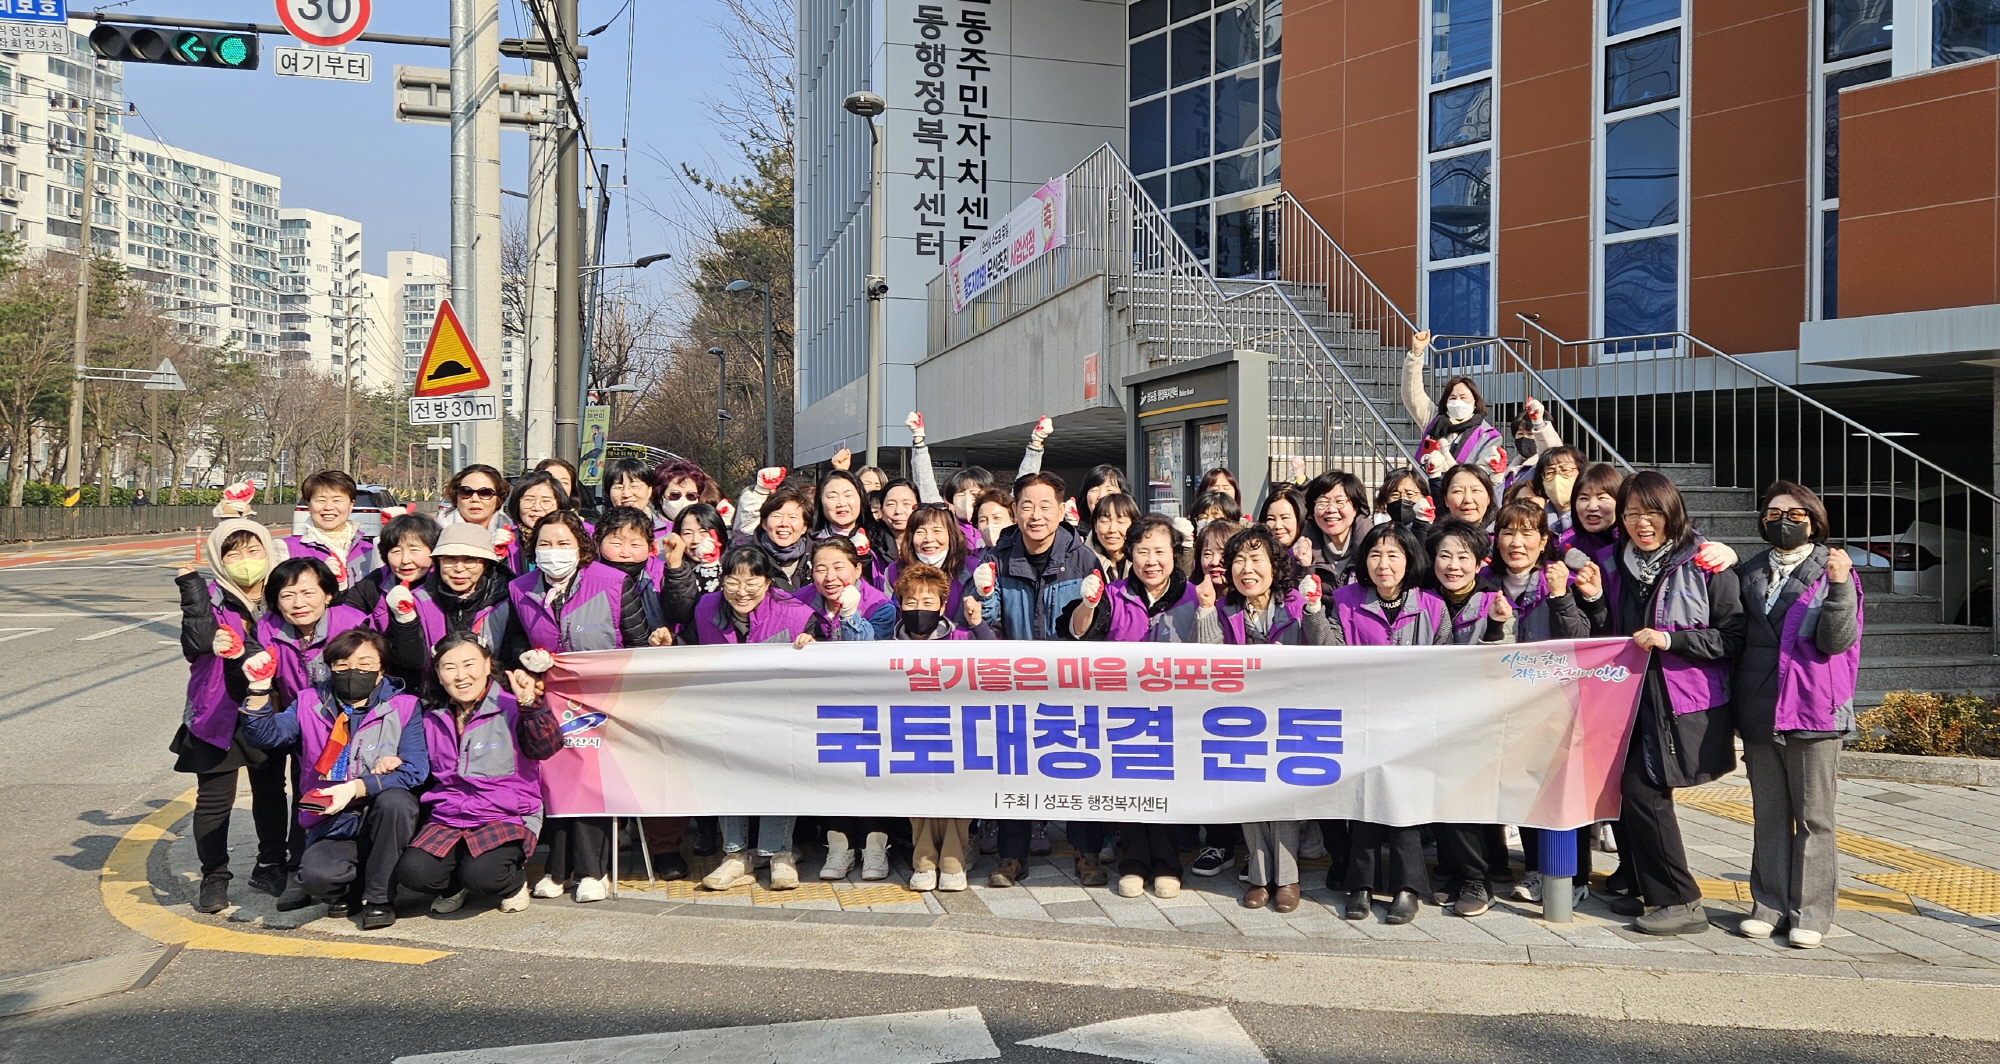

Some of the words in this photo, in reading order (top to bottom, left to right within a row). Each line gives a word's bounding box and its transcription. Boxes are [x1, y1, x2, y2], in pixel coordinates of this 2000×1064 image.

[298, 0, 351, 24] 30
[281, 52, 365, 78] 여기부터
[316, 264, 328, 273] 1011
[1500, 650, 1537, 669] 시민과
[890, 656, 1048, 692] "살기좋은
[1057, 656, 1128, 692] 마을
[1137, 656, 1261, 693] 성포동"
[1596, 666, 1625, 681] 안산
[816, 703, 1175, 780] 국토대청결
[1201, 706, 1343, 787] 운동
[1002, 793, 1030, 810] 주최
[1043, 794, 1084, 811] 성포동
[1088, 794, 1168, 813] 행정복지센터
